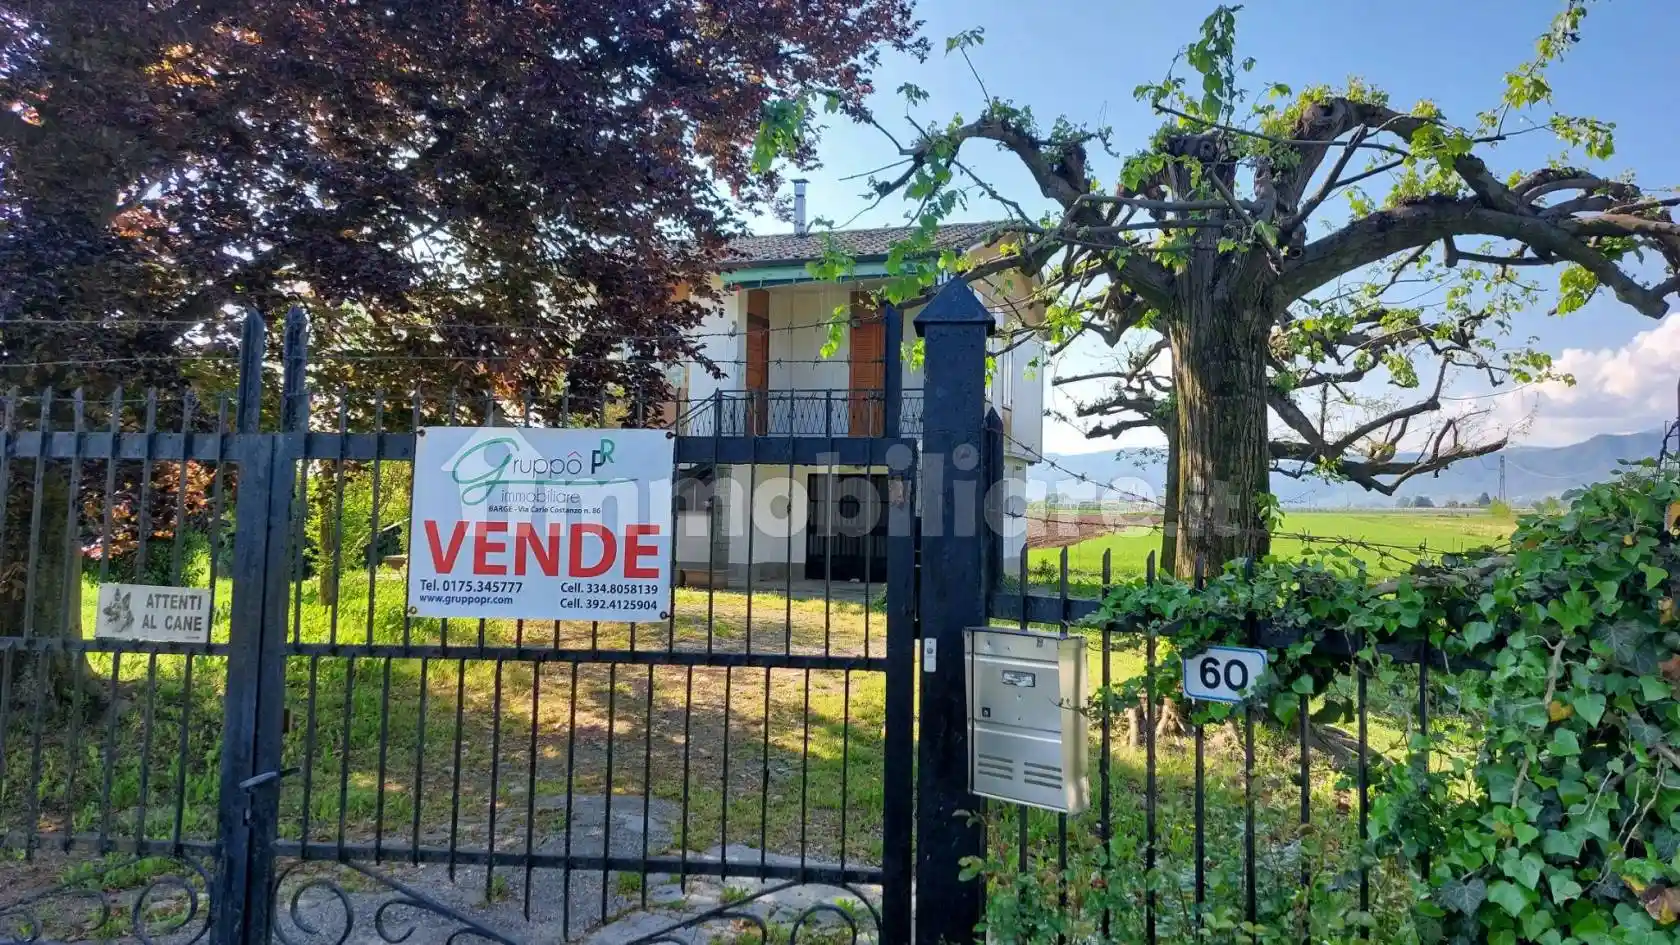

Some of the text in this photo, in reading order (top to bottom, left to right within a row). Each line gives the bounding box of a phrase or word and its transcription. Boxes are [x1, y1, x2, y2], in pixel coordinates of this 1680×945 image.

[501, 489, 581, 503] immobiliare
[424, 520, 660, 579] VENDE
[420, 579, 523, 594] Tel. 0175.345777
[560, 582, 659, 595] Cell. 334.8058139
[146, 593, 203, 611] ATTENTI
[419, 594, 513, 606] www.gruppopr.com
[560, 598, 658, 611] Cell. 392.4125904
[141, 614, 203, 632] AL CANE
[1199, 656, 1249, 692] 60
